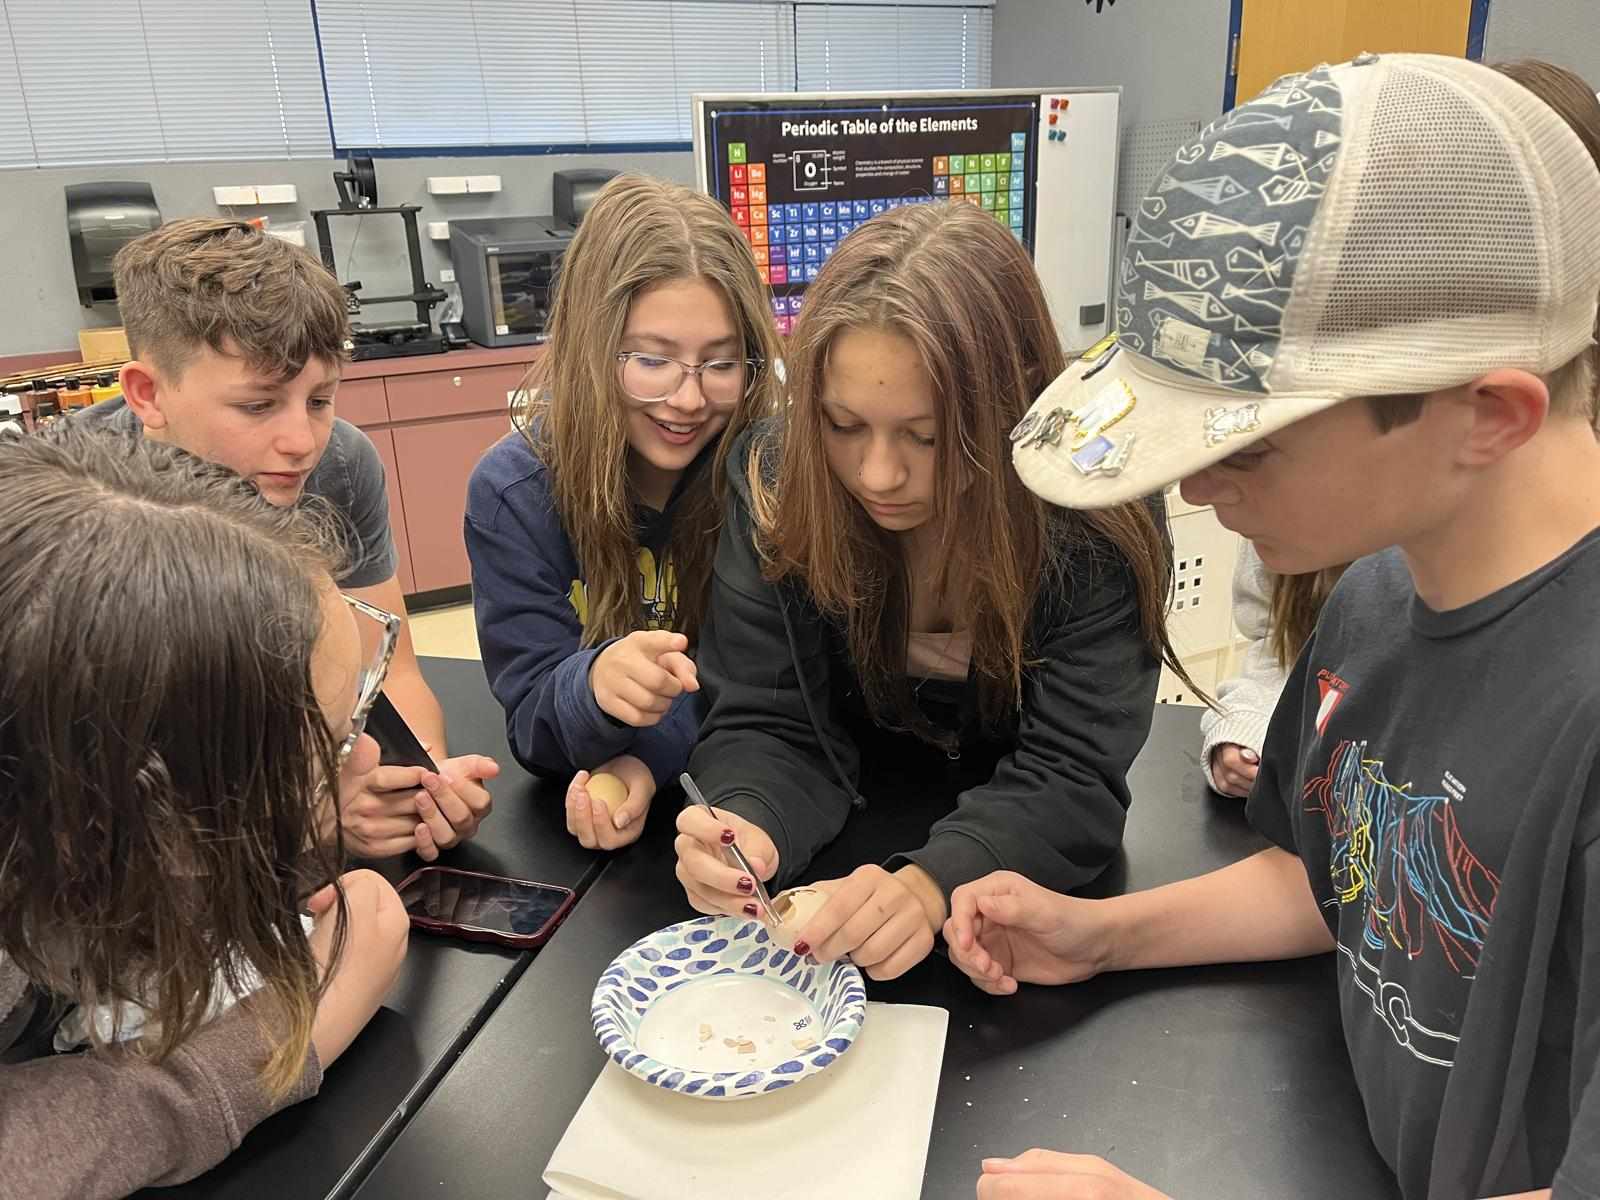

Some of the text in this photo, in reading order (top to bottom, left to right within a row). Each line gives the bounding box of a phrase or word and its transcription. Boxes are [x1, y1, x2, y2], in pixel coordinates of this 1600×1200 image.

[782, 117, 978, 136] Periodic Table of the Elements
[734, 148, 741, 158] H
[969, 160, 976, 168] N
[984, 159, 992, 167] O
[804, 162, 816, 178] O
[936, 180, 945, 189] Al
[808, 207, 814, 216] V
[823, 207, 832, 215] Cr
[856, 205, 865, 213] Fe
[873, 204, 883, 212] Co
[736, 211, 744, 221] K
[771, 210, 781, 218] Sc
[774, 230, 780, 239] Y
[790, 229, 799, 238] Zr
[823, 227, 834, 235] Mo
[790, 248, 800, 257] Hf
[807, 247, 816, 256] Ta
